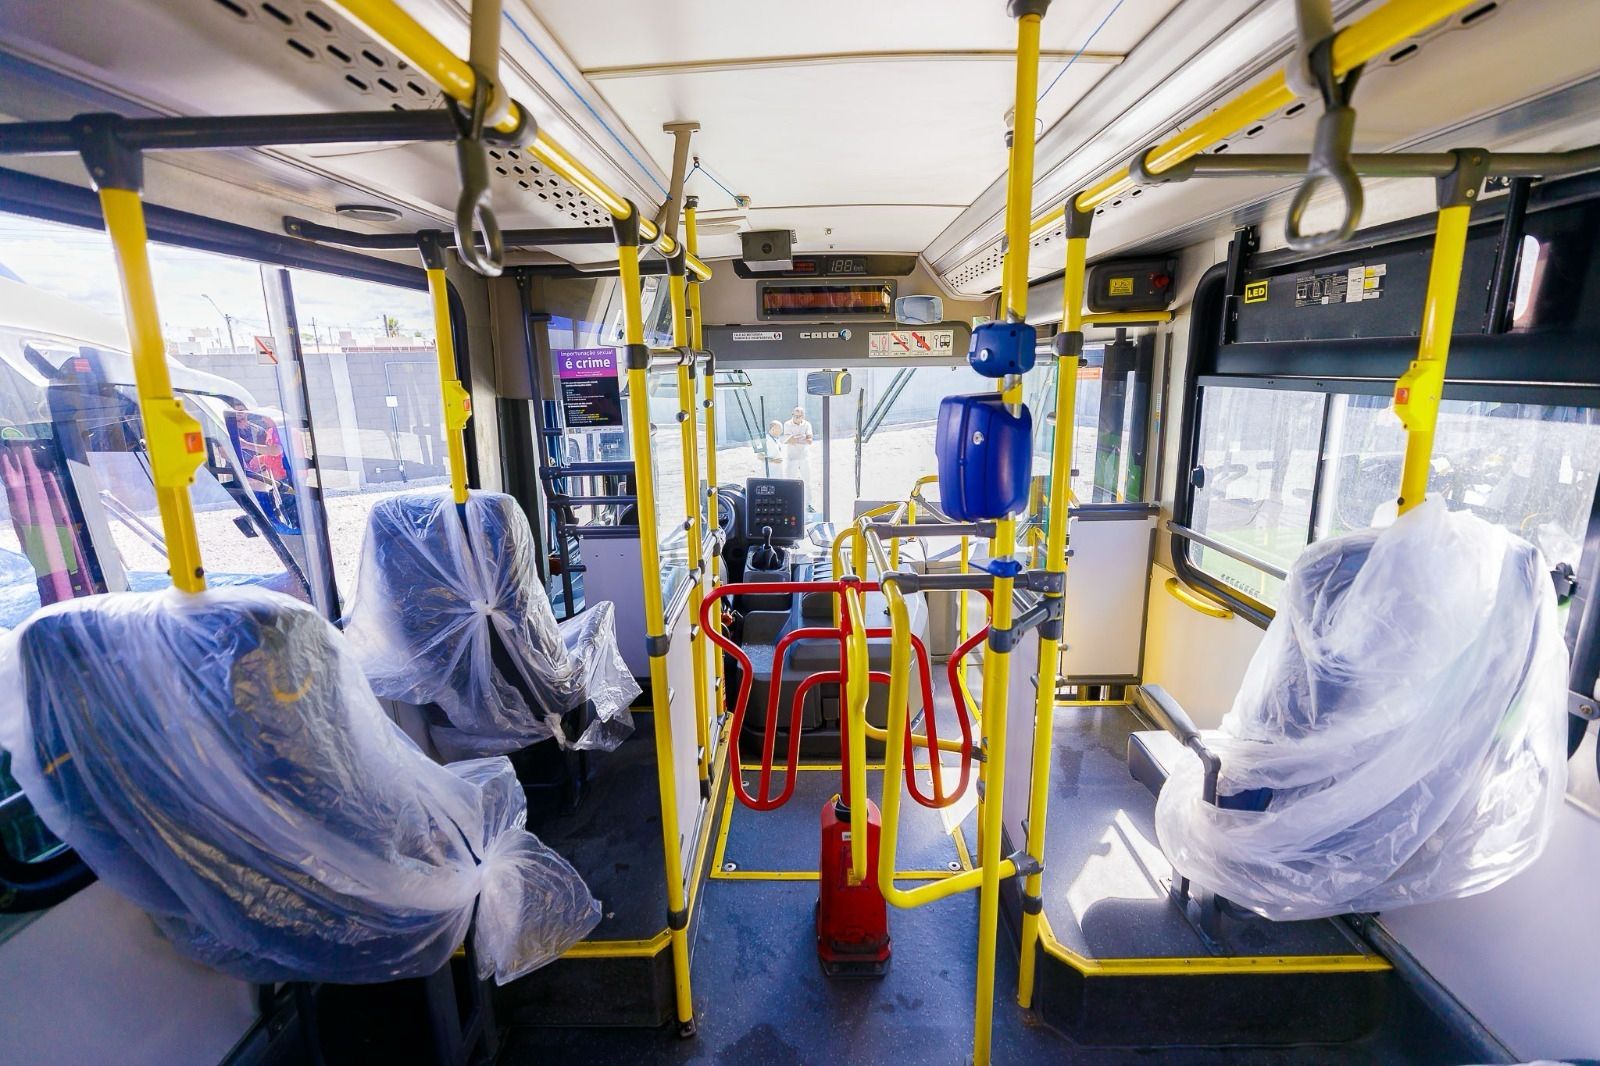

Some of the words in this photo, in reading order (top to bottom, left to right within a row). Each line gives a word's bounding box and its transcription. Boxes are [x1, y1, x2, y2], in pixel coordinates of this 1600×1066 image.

[831, 259, 853, 272] 188
[1248, 287, 1265, 298] LED
[565, 358, 573, 369] é
[576, 357, 611, 368] crime
